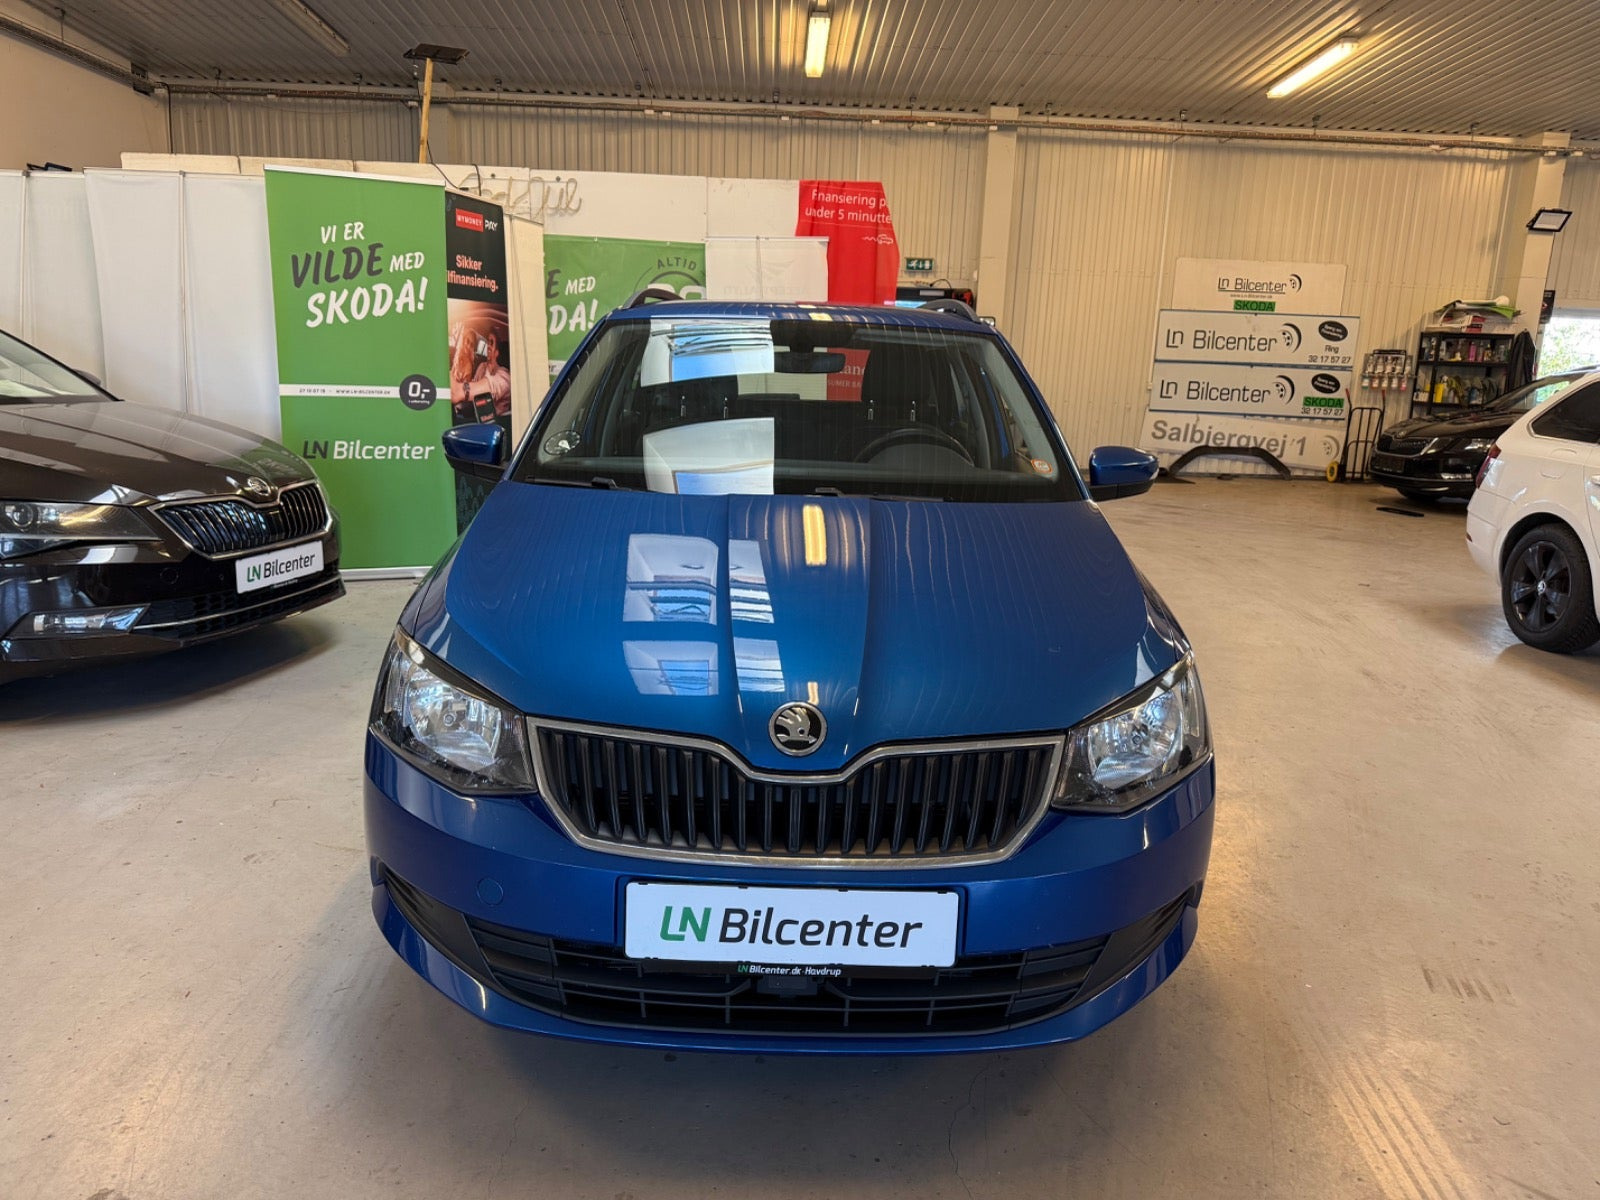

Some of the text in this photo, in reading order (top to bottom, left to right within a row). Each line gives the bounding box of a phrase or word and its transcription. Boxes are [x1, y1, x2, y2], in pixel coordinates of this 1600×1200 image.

[811, 188, 888, 209] Fnansiering p
[805, 206, 835, 219] under
[838, 209, 845, 220] 5
[321, 221, 365, 244] VI ER
[291, 243, 425, 289] VILDE MED
[456, 254, 483, 270] Sikker
[657, 256, 697, 271] ALTID
[565, 276, 596, 296] MED
[1235, 277, 1287, 292] Bilcenter
[306, 277, 428, 328] SKODA!
[1234, 300, 1274, 311] SKODA
[1192, 329, 1278, 352] Bilcenter
[1325, 345, 1340, 354] Ring
[1308, 355, 1318, 363] 32
[1320, 355, 1329, 363] 17
[1341, 356, 1351, 364] 27
[1186, 380, 1271, 403] Bilcenter
[1301, 407, 1311, 415] 32
[1333, 408, 1344, 416] 27
[1303, 397, 1343, 408] SKODA
[303, 439, 436, 459] LN Bilcenter
[1296, 436, 1306, 456] 1
[247, 553, 316, 583] LN Bilcenter
[660, 906, 923, 948] LN Bilcenter
[749, 965, 802, 975] Bilcenter.dk
[804, 966, 842, 977] Havdrup
